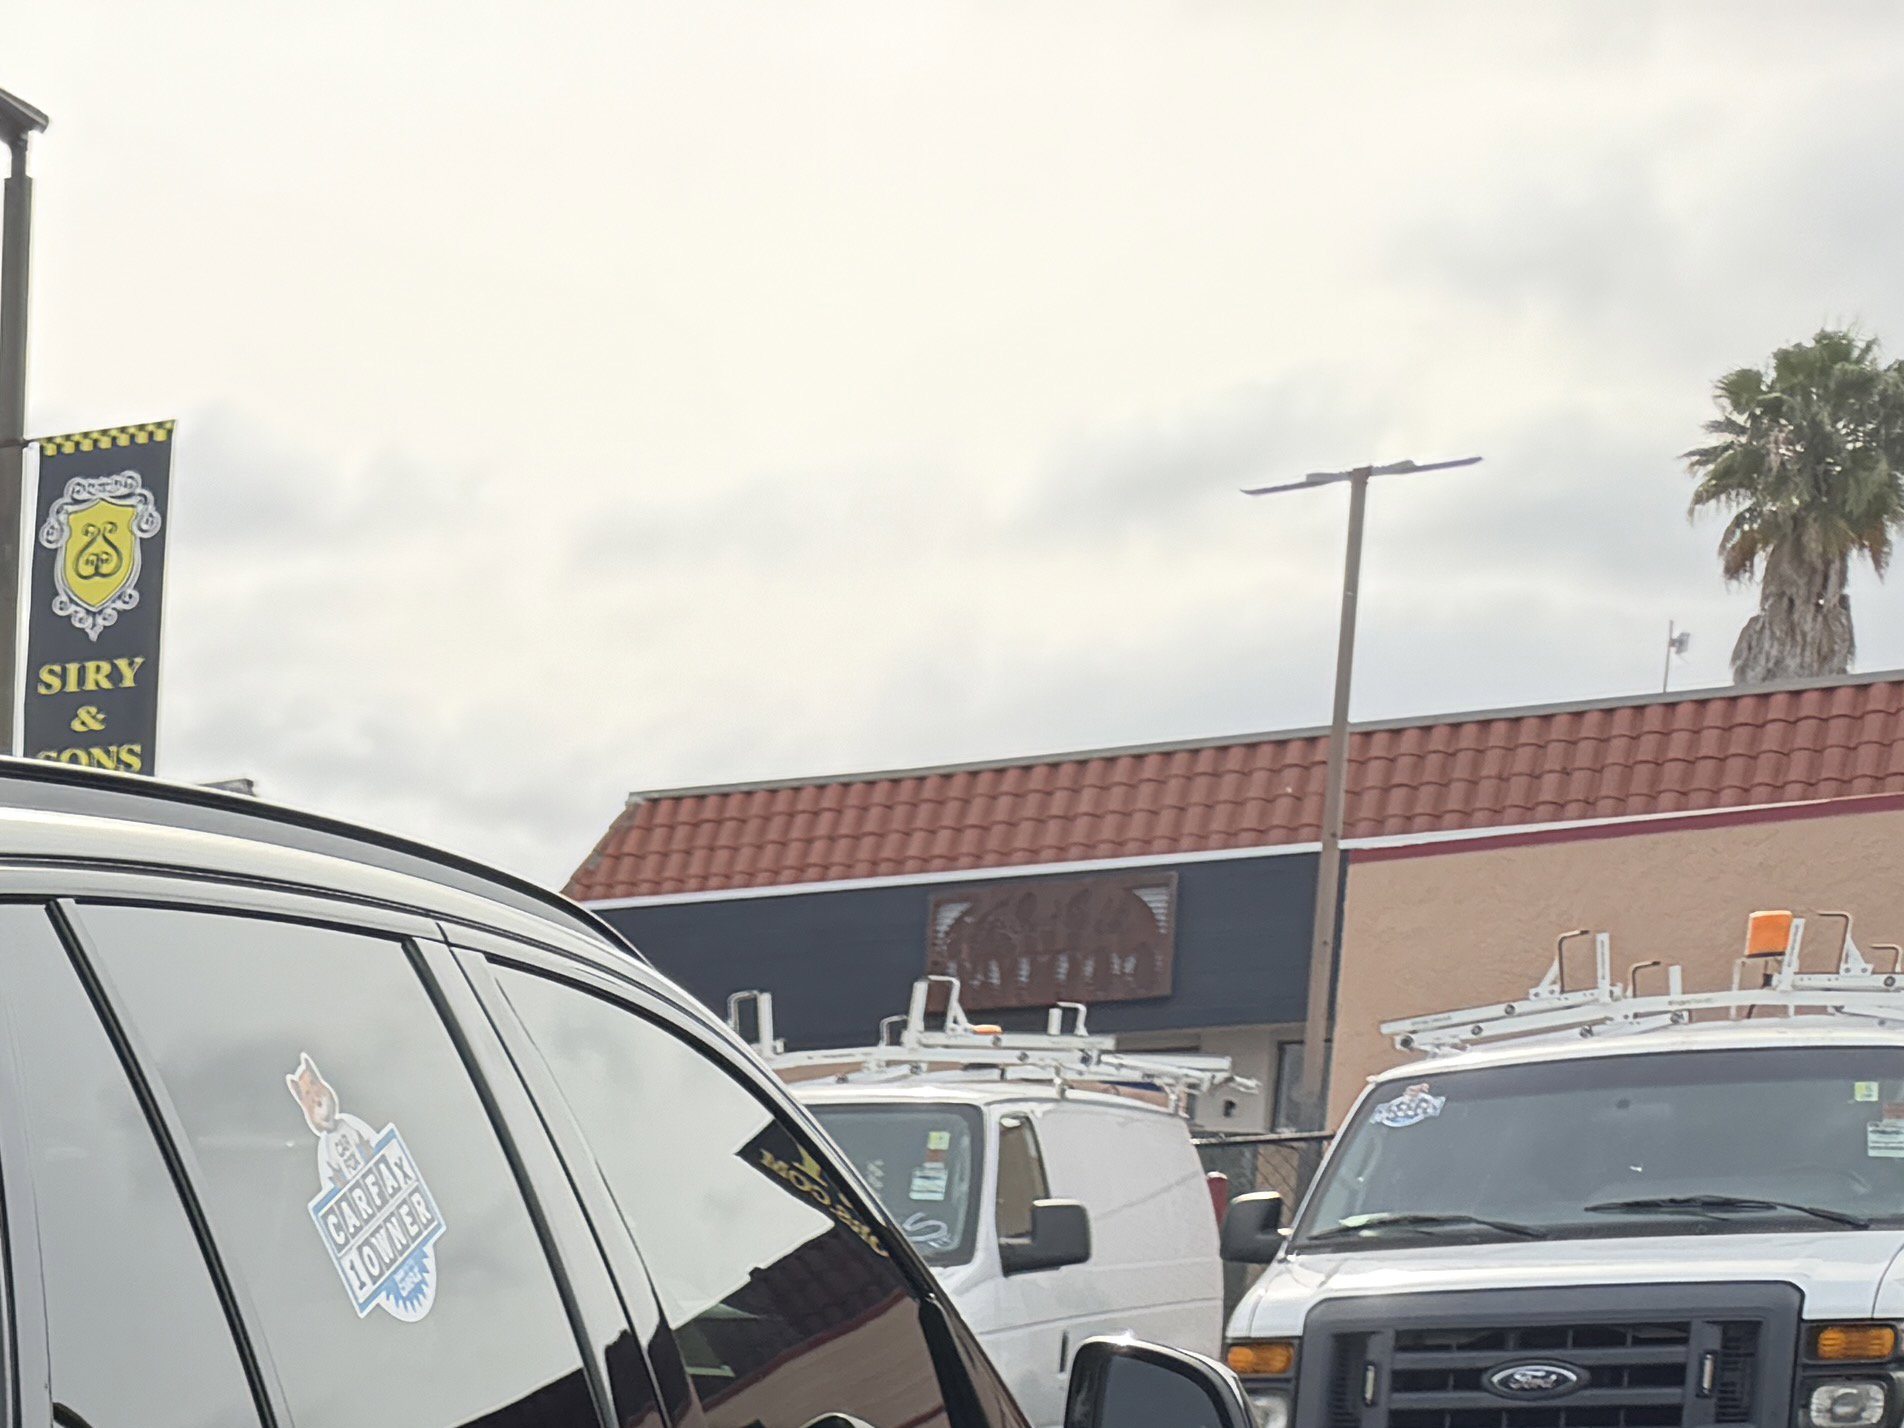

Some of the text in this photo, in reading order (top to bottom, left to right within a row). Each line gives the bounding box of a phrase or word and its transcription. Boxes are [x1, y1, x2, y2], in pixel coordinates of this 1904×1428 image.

[37, 657, 145, 695] SIRY
[71, 705, 106, 733] &
[327, 1156, 415, 1244] CARFAX
[363, 1193, 432, 1276] OWNER
